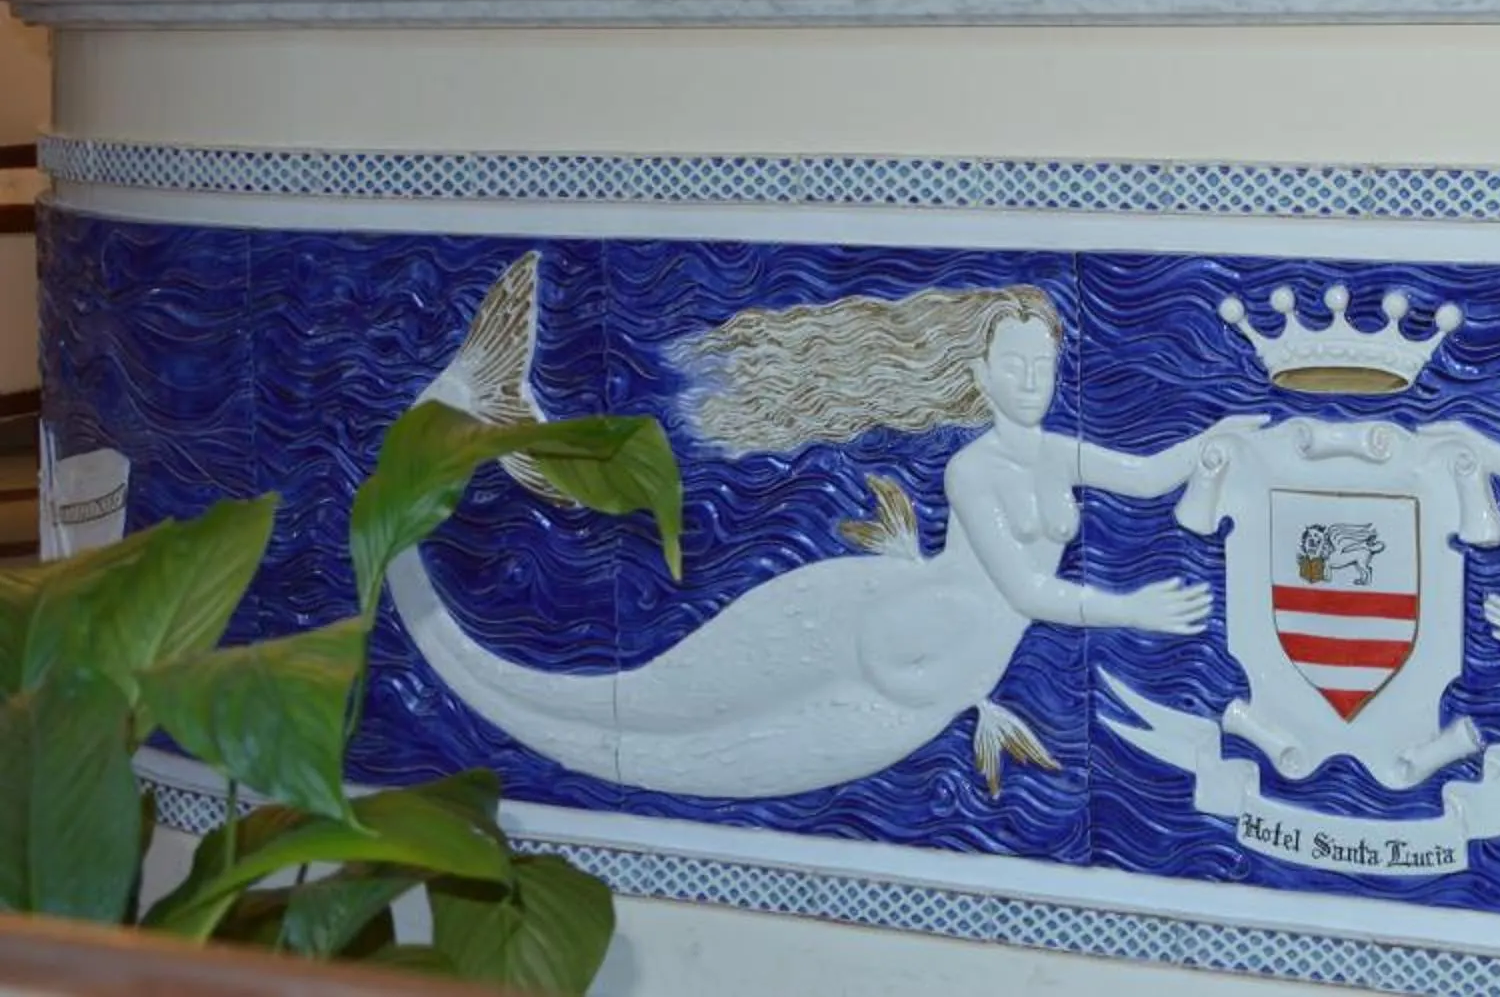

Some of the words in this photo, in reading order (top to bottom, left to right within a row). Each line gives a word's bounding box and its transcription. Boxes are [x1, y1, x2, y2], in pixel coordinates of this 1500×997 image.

[1242, 813, 1300, 852] Hotel
[1311, 832, 1380, 865] Santa
[1384, 840, 1457, 867] Lucia
